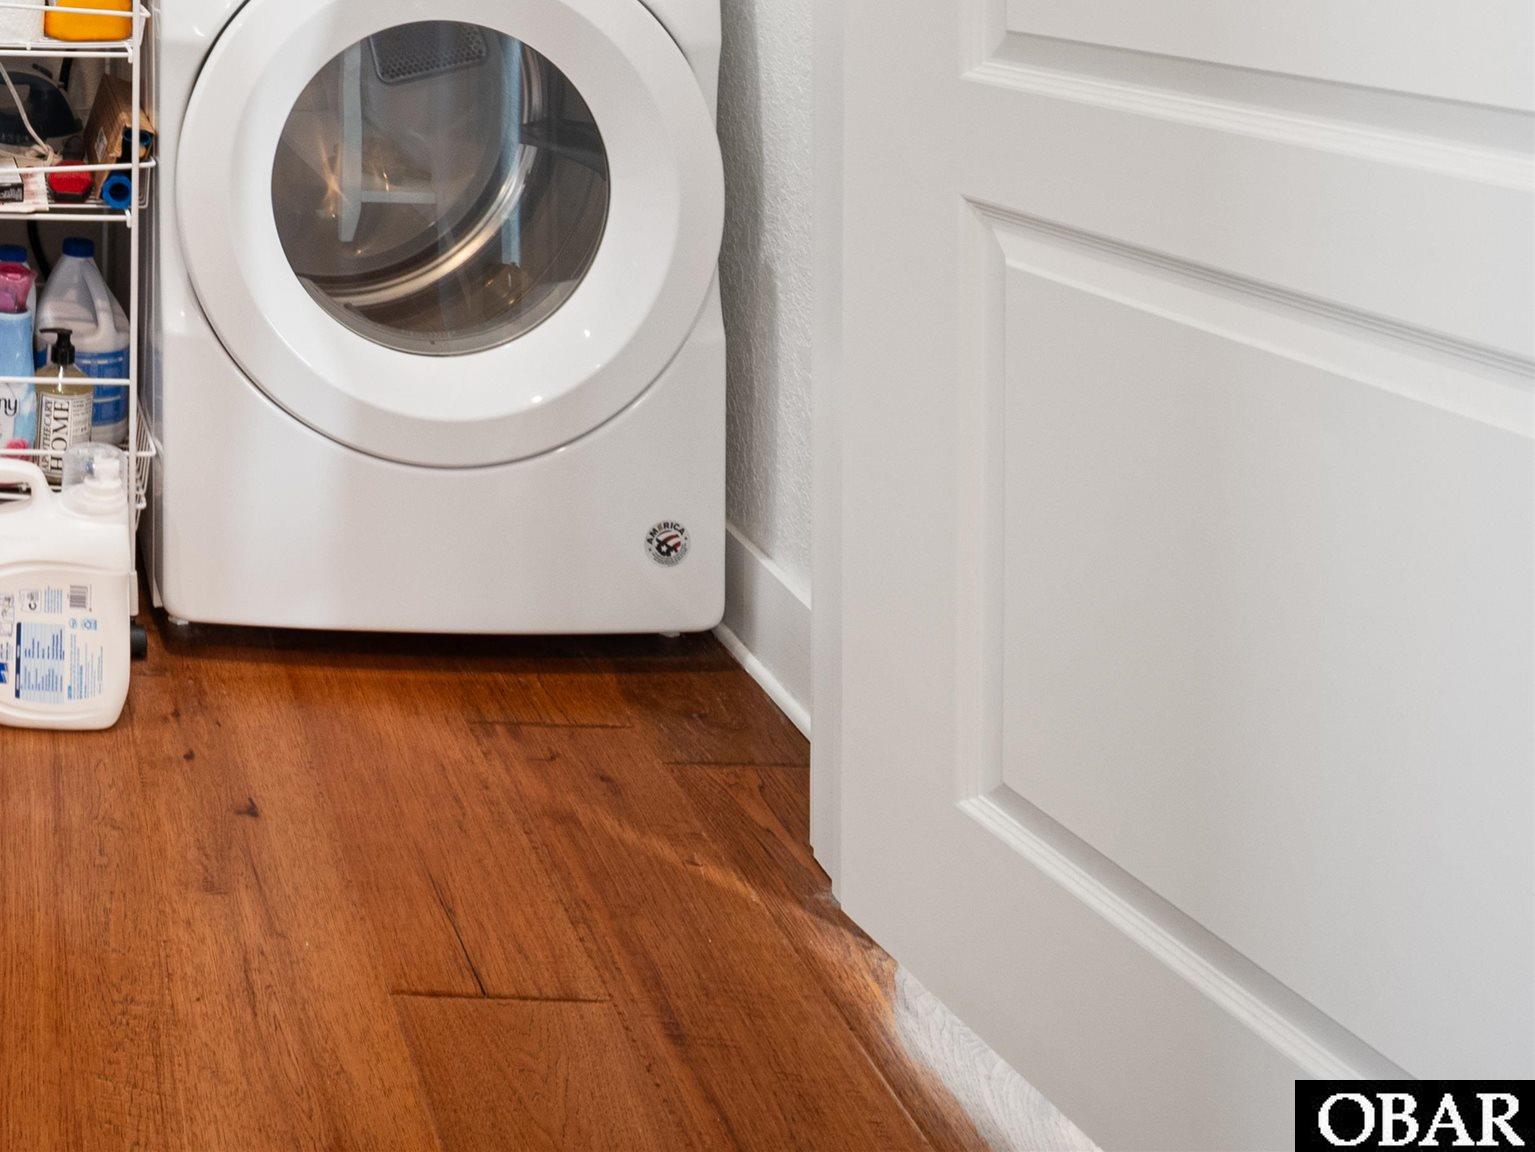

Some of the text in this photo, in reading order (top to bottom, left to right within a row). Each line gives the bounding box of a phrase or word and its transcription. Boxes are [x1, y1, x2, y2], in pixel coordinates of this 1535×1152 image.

[41, 400, 53, 468] APTHECARY
[50, 401, 70, 470] HOME
[647, 521, 685, 545] AMERICA
